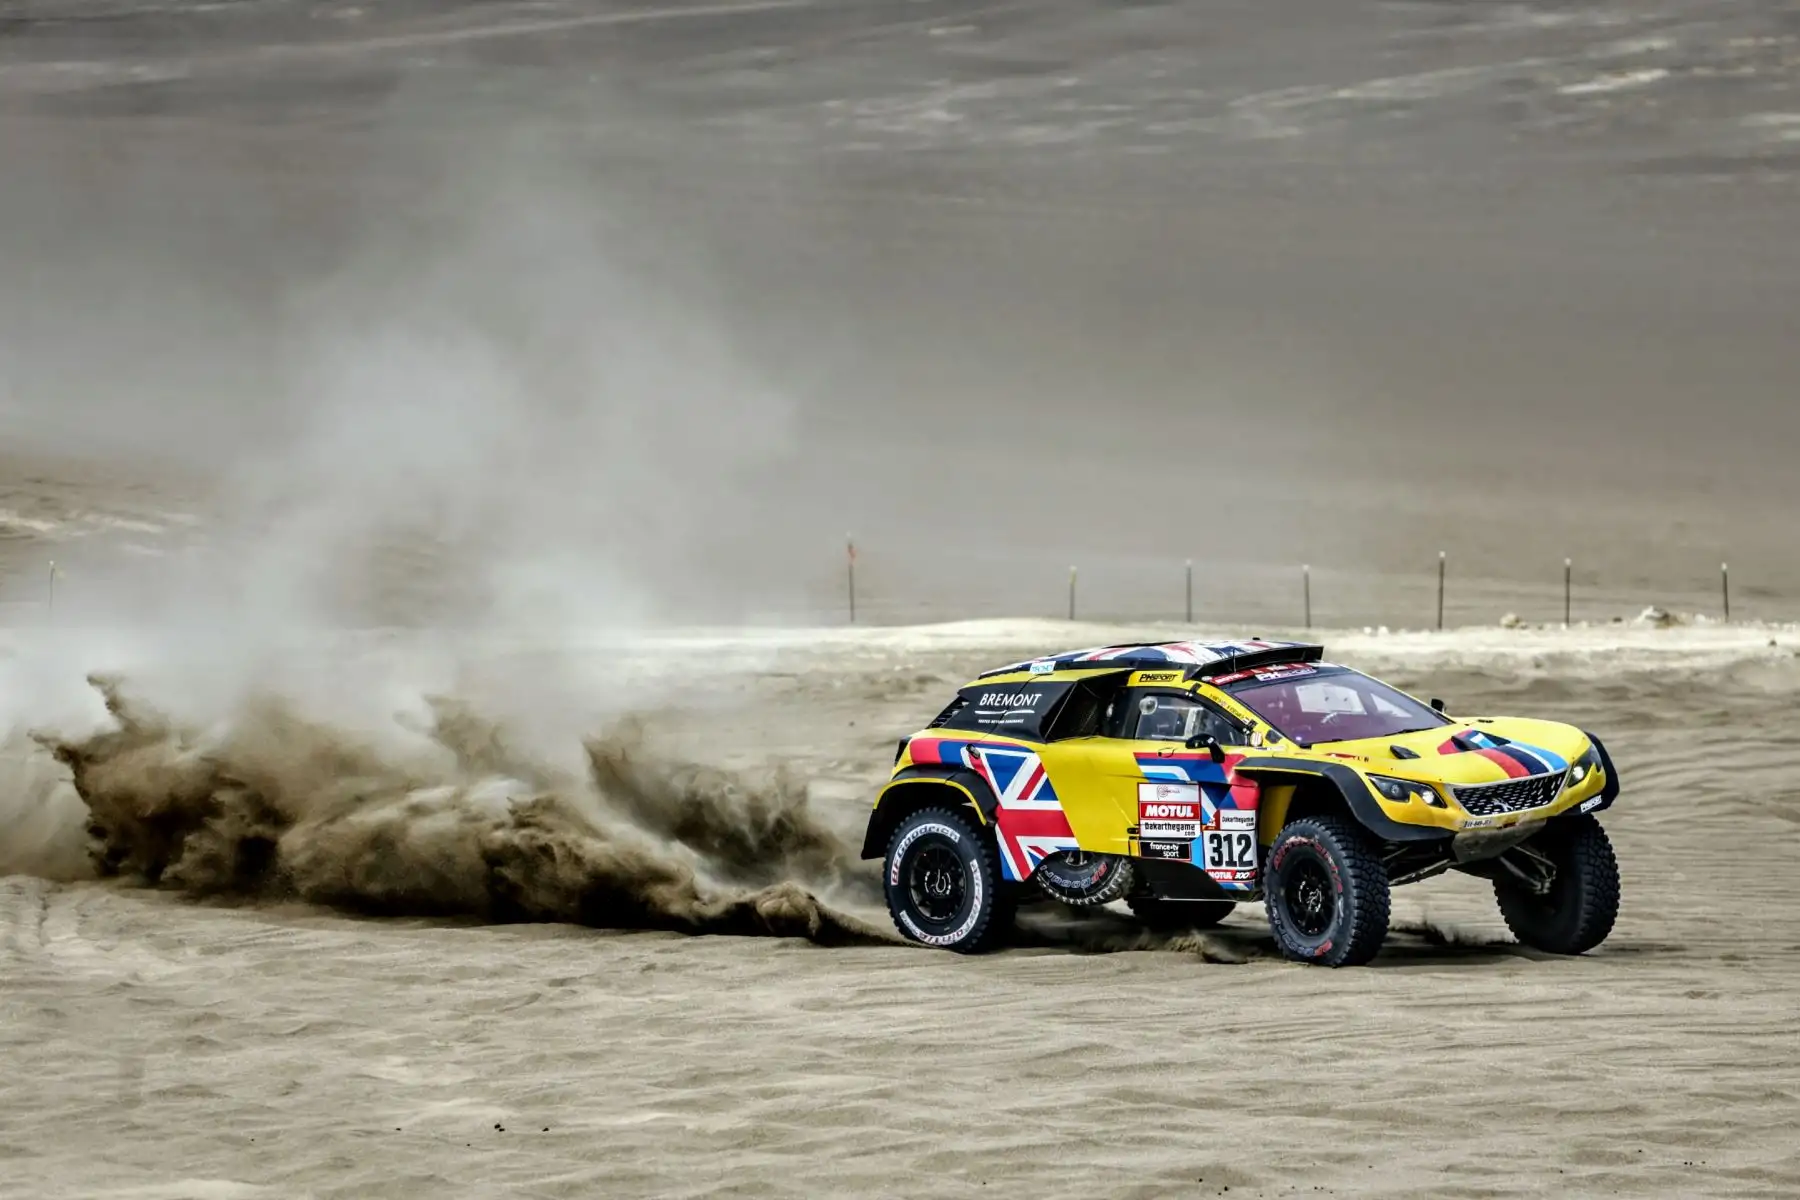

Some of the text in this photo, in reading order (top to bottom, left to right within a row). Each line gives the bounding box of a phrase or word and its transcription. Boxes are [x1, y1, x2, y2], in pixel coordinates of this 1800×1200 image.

[979, 693, 1042, 707] BREMONT
[1145, 804, 1194, 817] MOTUL
[891, 823, 961, 886] BFGoodrich
[1163, 850, 1179, 858] sport
[1209, 833, 1254, 867] 312
